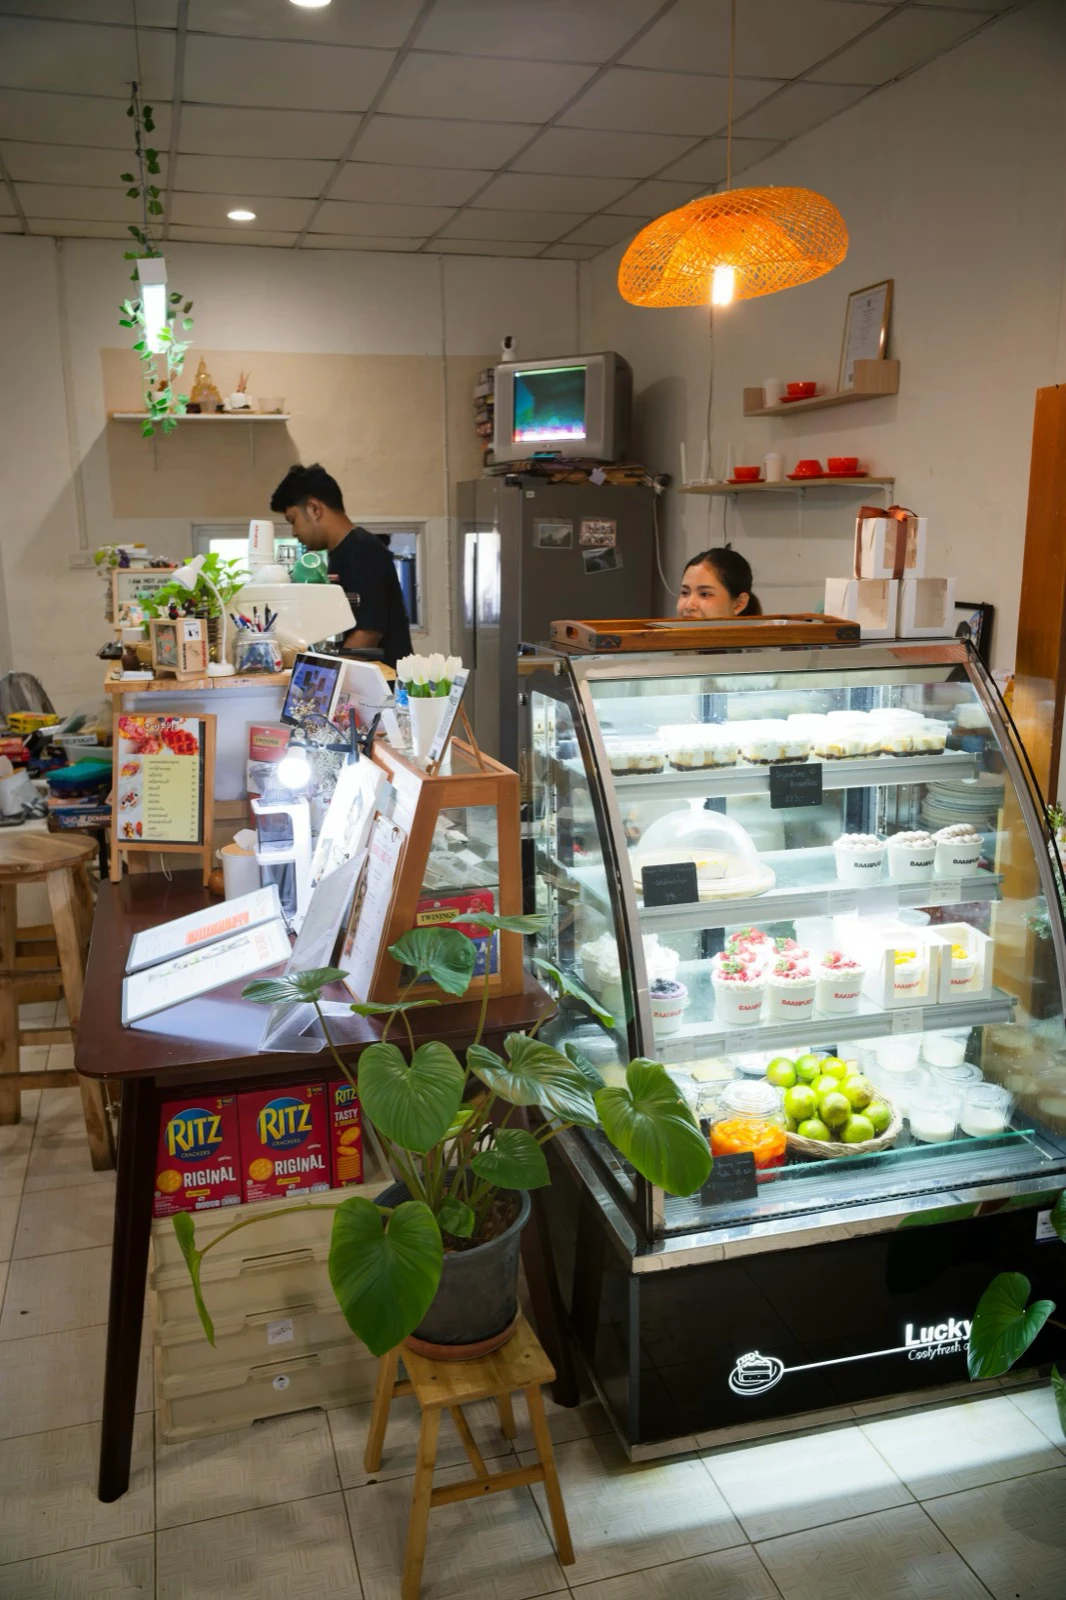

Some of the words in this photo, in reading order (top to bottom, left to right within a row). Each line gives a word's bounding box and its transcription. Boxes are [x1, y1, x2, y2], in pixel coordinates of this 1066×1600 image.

[421, 911, 456, 922] TWININGS
[335, 1088, 357, 1106] RITZ
[260, 1103, 312, 1144] RITZ
[334, 1108, 358, 1121] TASTY
[168, 1115, 223, 1156] RITZ
[905, 1318, 972, 1346] Lucky
